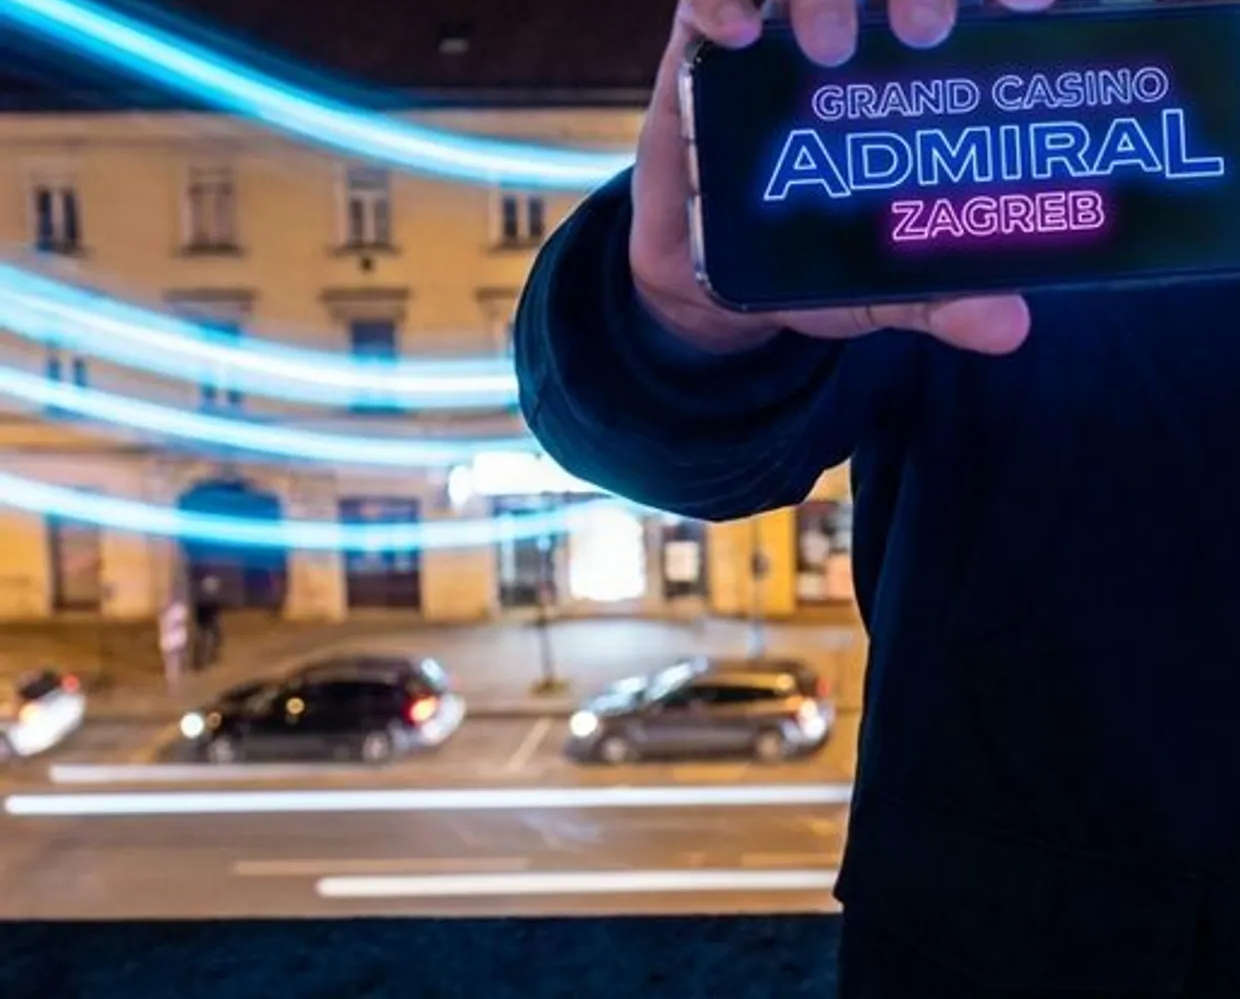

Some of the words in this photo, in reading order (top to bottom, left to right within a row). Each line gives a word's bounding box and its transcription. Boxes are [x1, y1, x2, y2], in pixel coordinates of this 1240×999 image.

[811, 79, 980, 120] GRAND
[992, 68, 1169, 110] CASINO
[764, 109, 1224, 200] ADMIRAL
[892, 191, 1105, 241] ZAGREB
